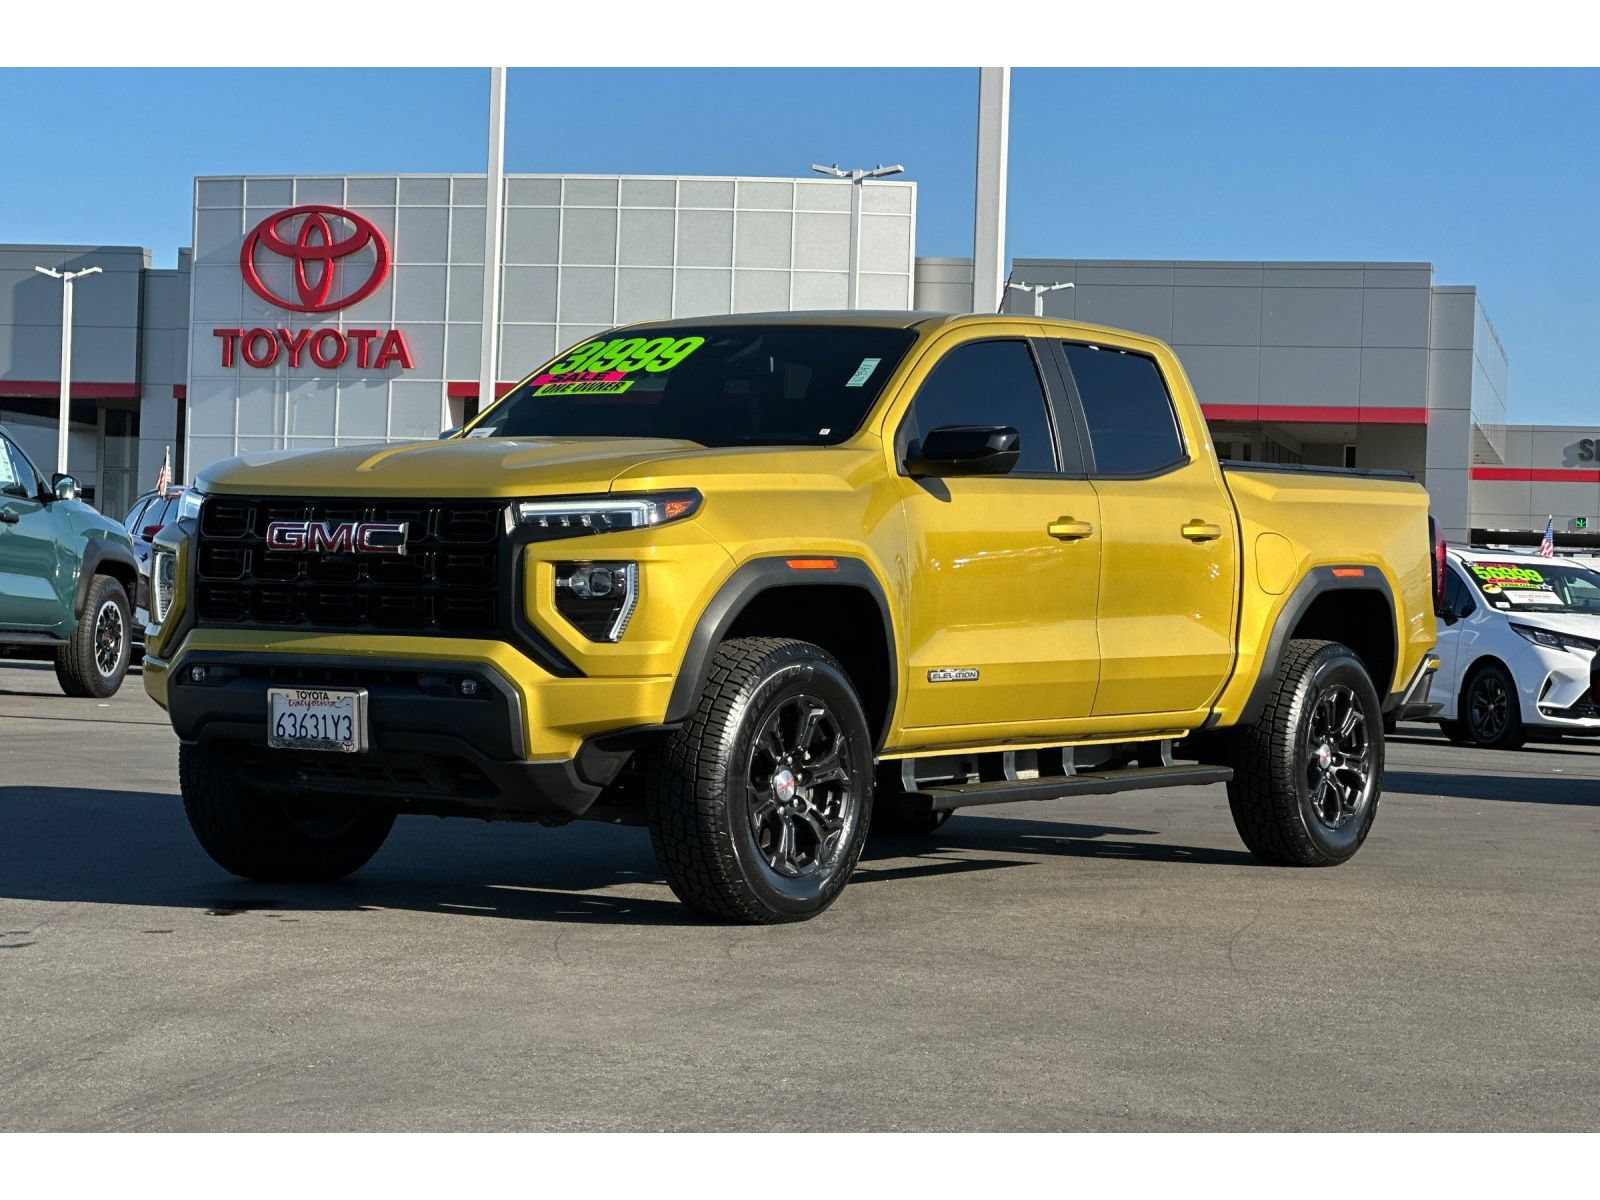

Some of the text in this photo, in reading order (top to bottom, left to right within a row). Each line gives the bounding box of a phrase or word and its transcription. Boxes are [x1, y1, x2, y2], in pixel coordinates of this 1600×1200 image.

[213, 328, 414, 369] TOYOTA
[549, 336, 705, 375] 31999
[550, 372, 606, 383] SALE
[542, 382, 622, 393] ONE OWNER
[266, 521, 409, 556] GMC
[1471, 567, 1544, 582] 56999
[295, 691, 329, 700] TOYOTA
[288, 699, 338, 711] California
[276, 712, 352, 740] 63631Y3
